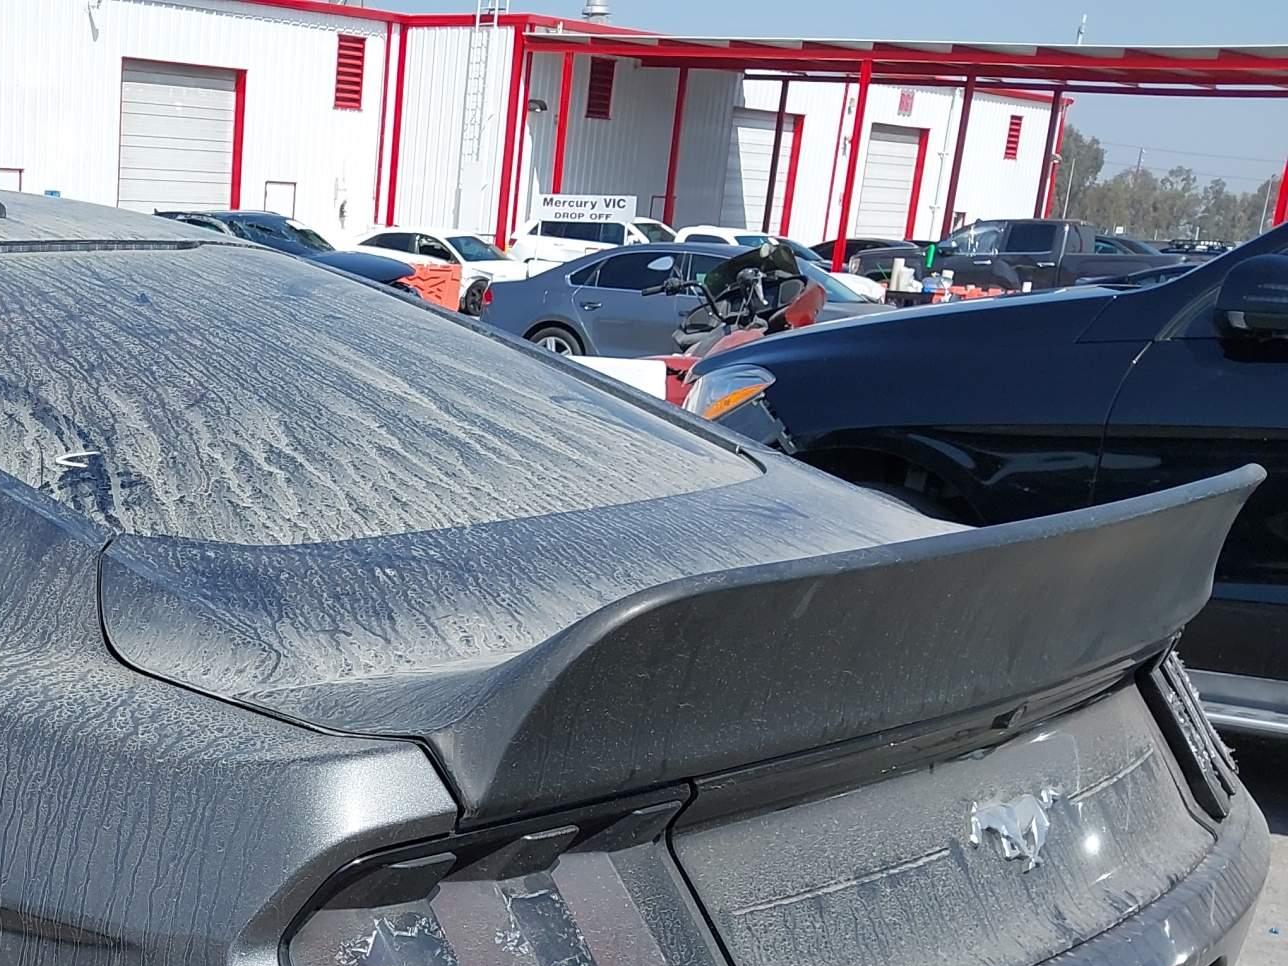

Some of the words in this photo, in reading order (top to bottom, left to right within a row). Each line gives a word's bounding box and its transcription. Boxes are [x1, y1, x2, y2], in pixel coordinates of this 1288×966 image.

[543, 197, 597, 210] Mercury
[603, 198, 626, 209] VIC
[554, 211, 585, 219] DROP
[589, 213, 612, 221] OFF
